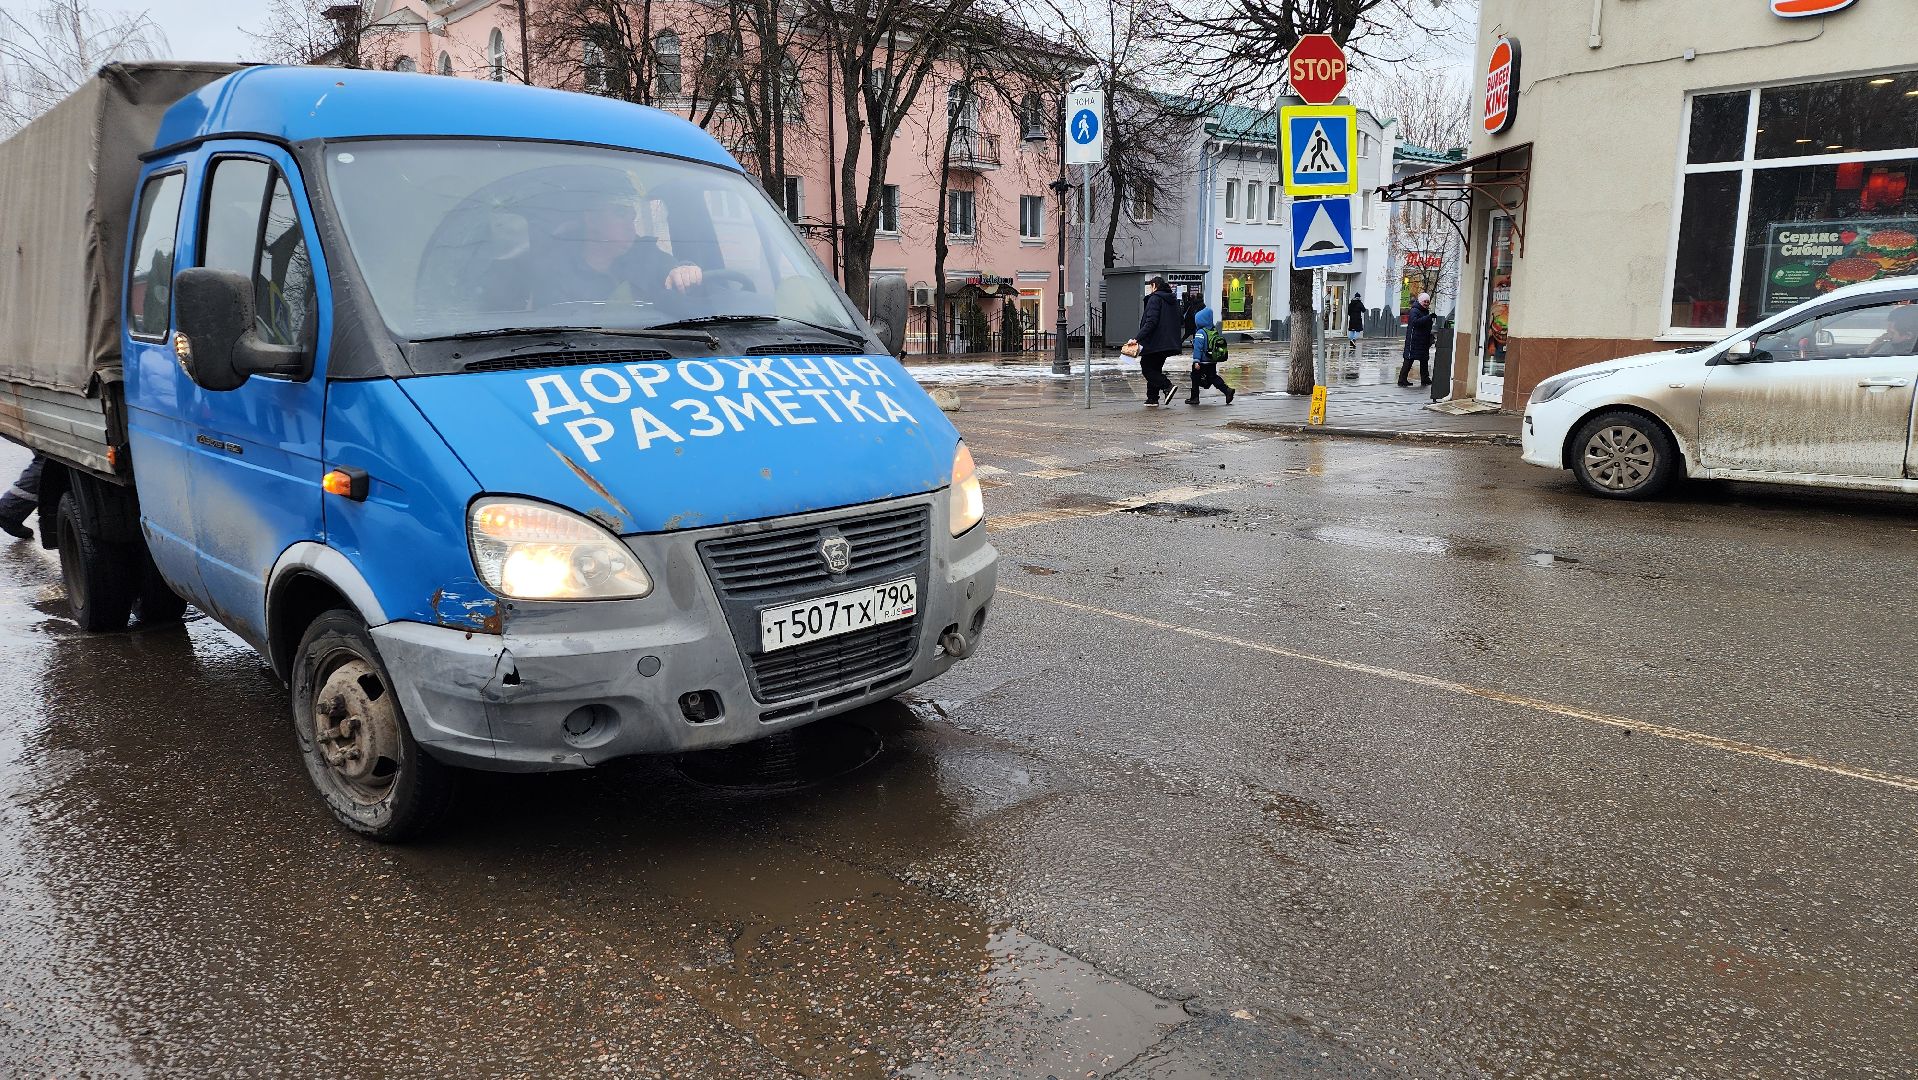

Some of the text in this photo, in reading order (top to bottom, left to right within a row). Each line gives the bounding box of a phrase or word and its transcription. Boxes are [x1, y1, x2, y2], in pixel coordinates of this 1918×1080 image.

[1293, 58, 1345, 81] STOP
[1487, 66, 1509, 93] BURGER
[1485, 84, 1509, 116] KING
[1779, 232, 1839, 246] Сердце
[1781, 244, 1844, 258] Сибири
[1226, 245, 1275, 266] Тофа
[526, 357, 896, 425] ДОРОЖНАЯ
[563, 389, 919, 462] РАЗМЕТКА
[773, 583, 912, 643] Т507ТХ 790
